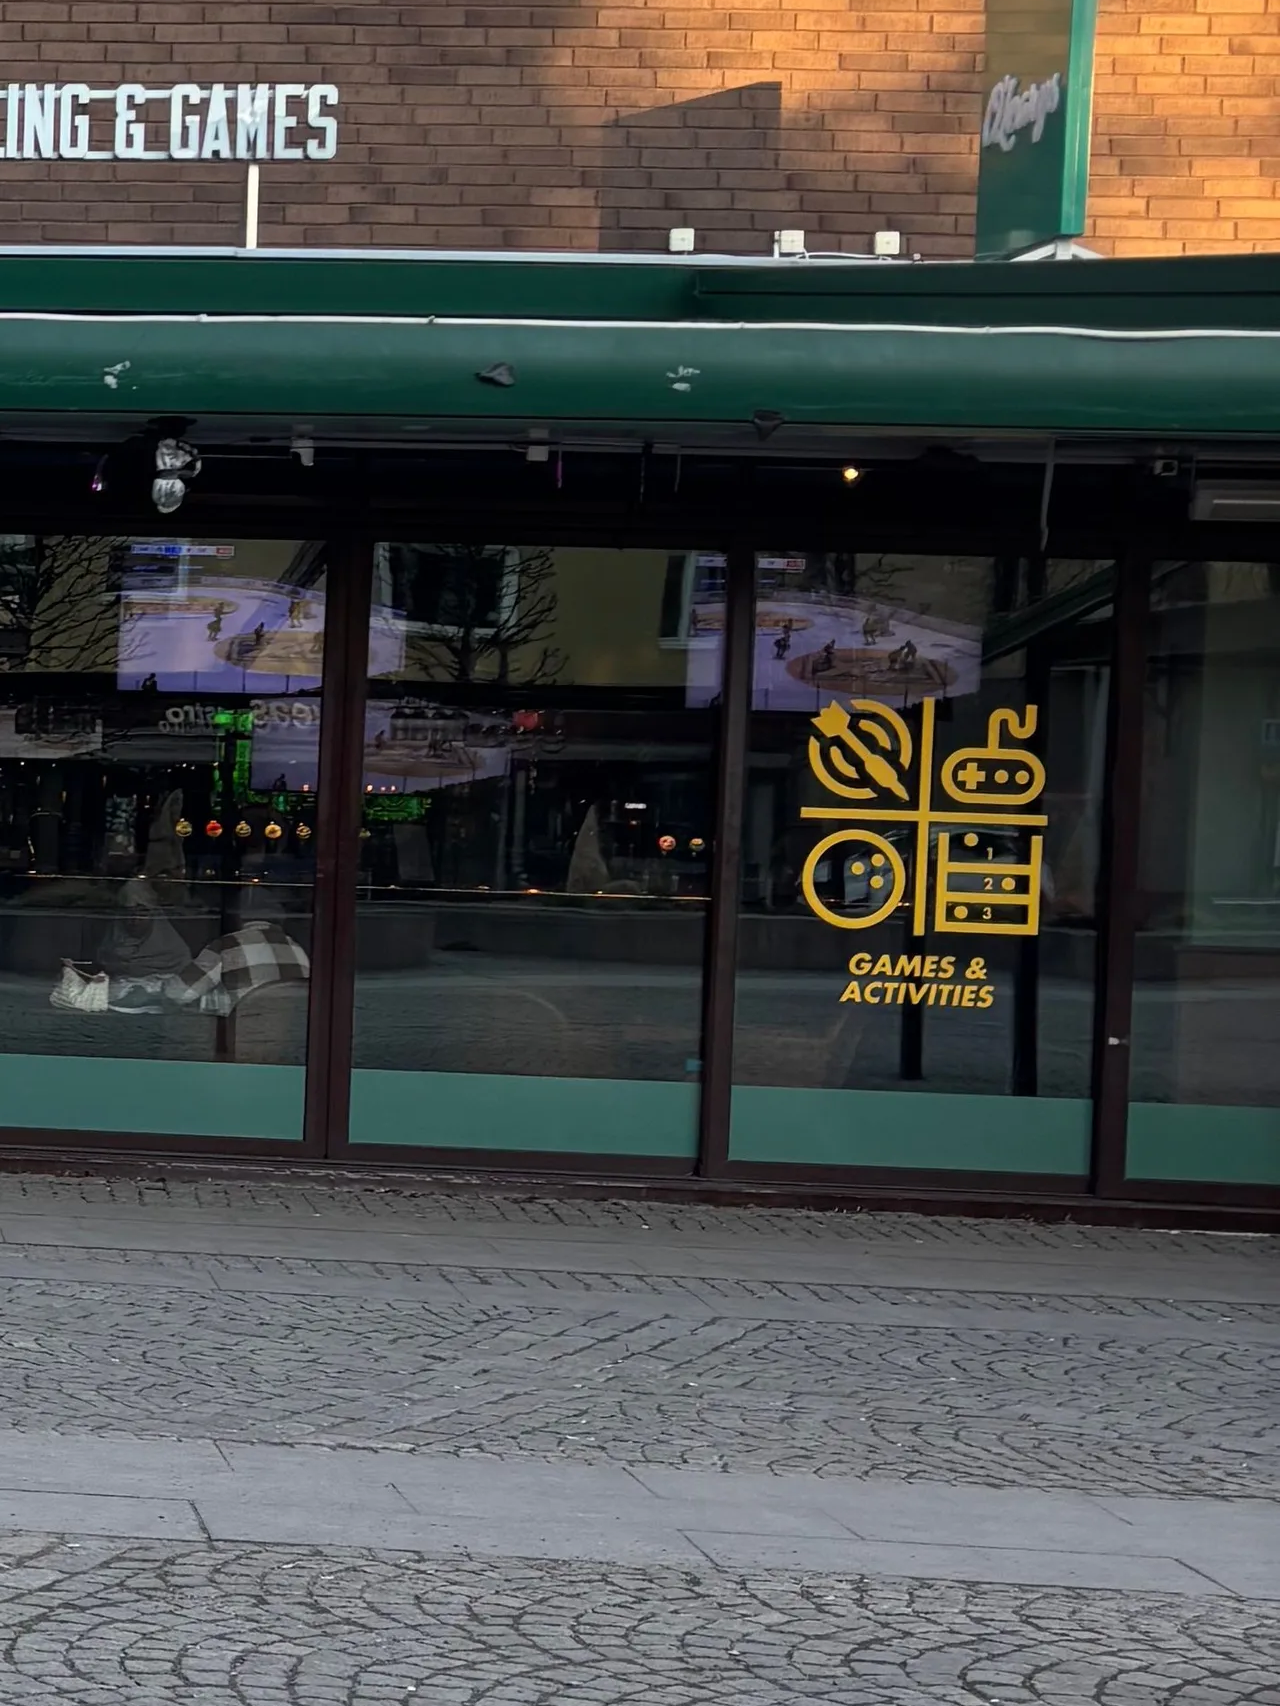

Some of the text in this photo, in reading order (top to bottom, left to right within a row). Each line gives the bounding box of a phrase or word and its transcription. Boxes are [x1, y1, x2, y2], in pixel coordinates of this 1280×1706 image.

[114, 83, 146, 160] &
[169, 83, 339, 160] GAMES
[986, 847, 993, 860] 1
[983, 878, 993, 890] 2
[982, 907, 992, 919] 3
[848, 952, 987, 979] GAMES &
[839, 981, 995, 1008] ACTIVITIES
